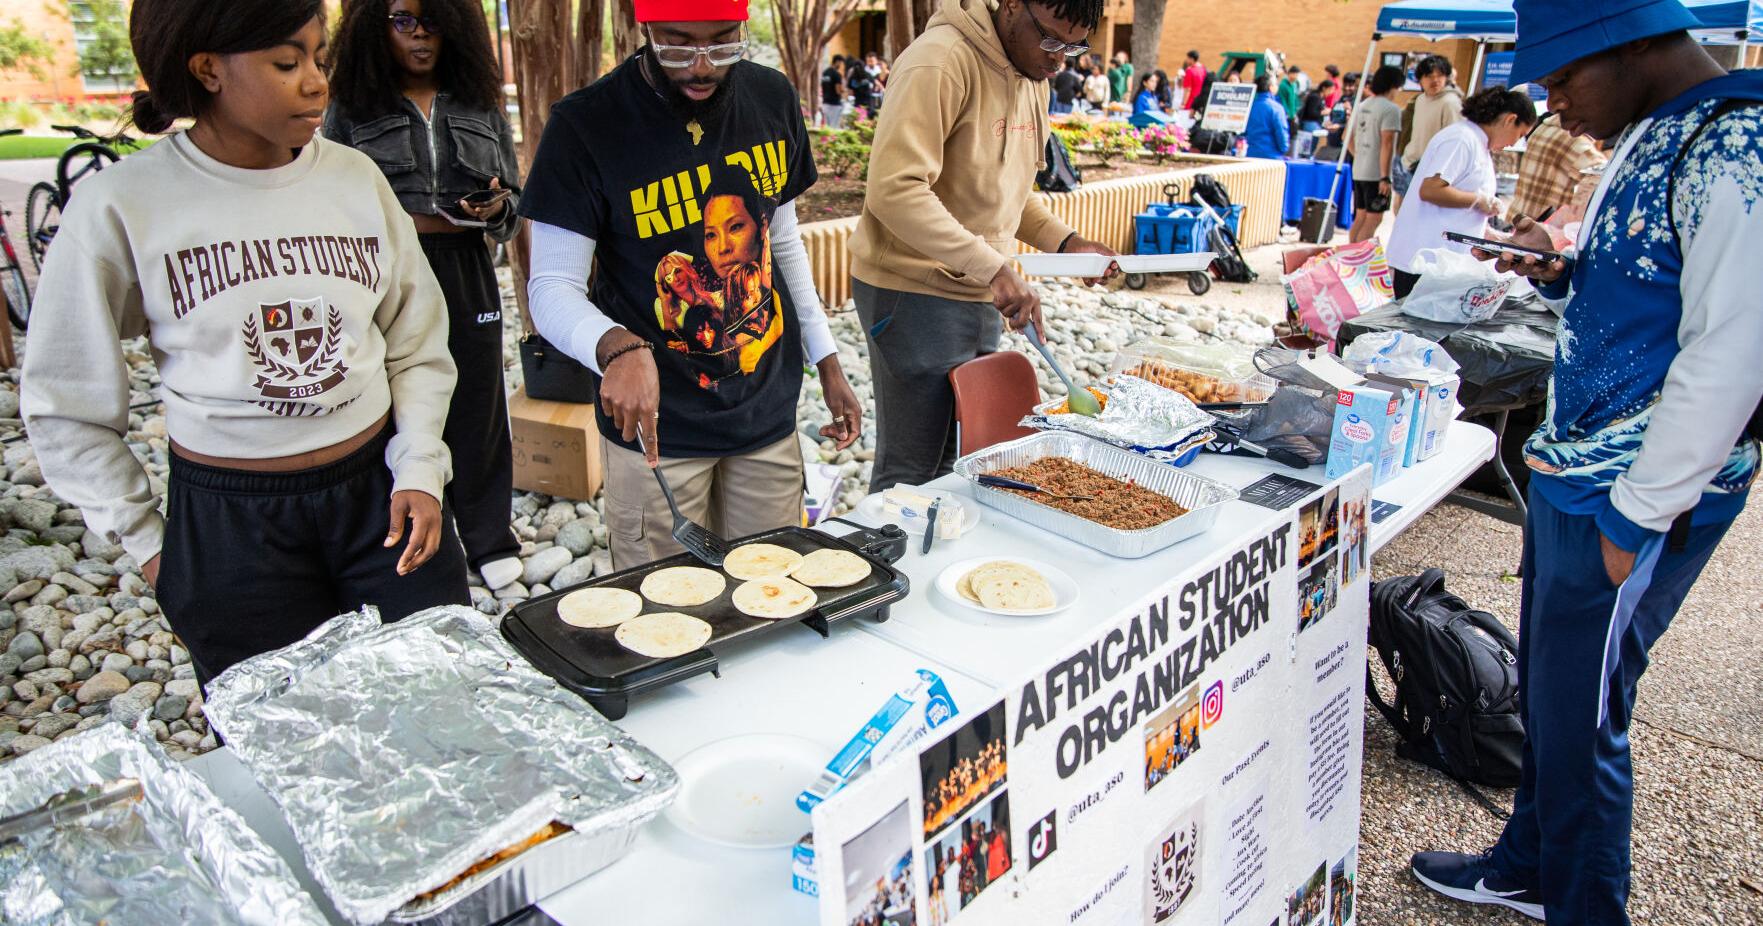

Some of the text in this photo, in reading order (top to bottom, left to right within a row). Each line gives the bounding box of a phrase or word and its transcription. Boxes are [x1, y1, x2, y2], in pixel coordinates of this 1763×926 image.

[164, 235, 380, 320] AFRICAN STUDENT
[477, 310, 501, 323] USA
[289, 383, 323, 398] 2023
[1339, 392, 1352, 402] 120
[1013, 521, 1293, 748] AFRICAN STUDENT
[1231, 652, 1271, 693] @uta_aso
[1315, 653, 1331, 671] Want
[1317, 656, 1344, 683] member?
[1056, 581, 1270, 780] ORGANIZATION
[1222, 740, 1270, 786] Our Past Events
[1068, 771, 1124, 824] @uta_aso
[1232, 813, 1246, 828] Date
[1232, 824, 1246, 840] Love
[1225, 868, 1247, 891] Coming
[1071, 901, 1090, 923] How
[1093, 891, 1104, 904] do
[1108, 864, 1129, 893] join?
